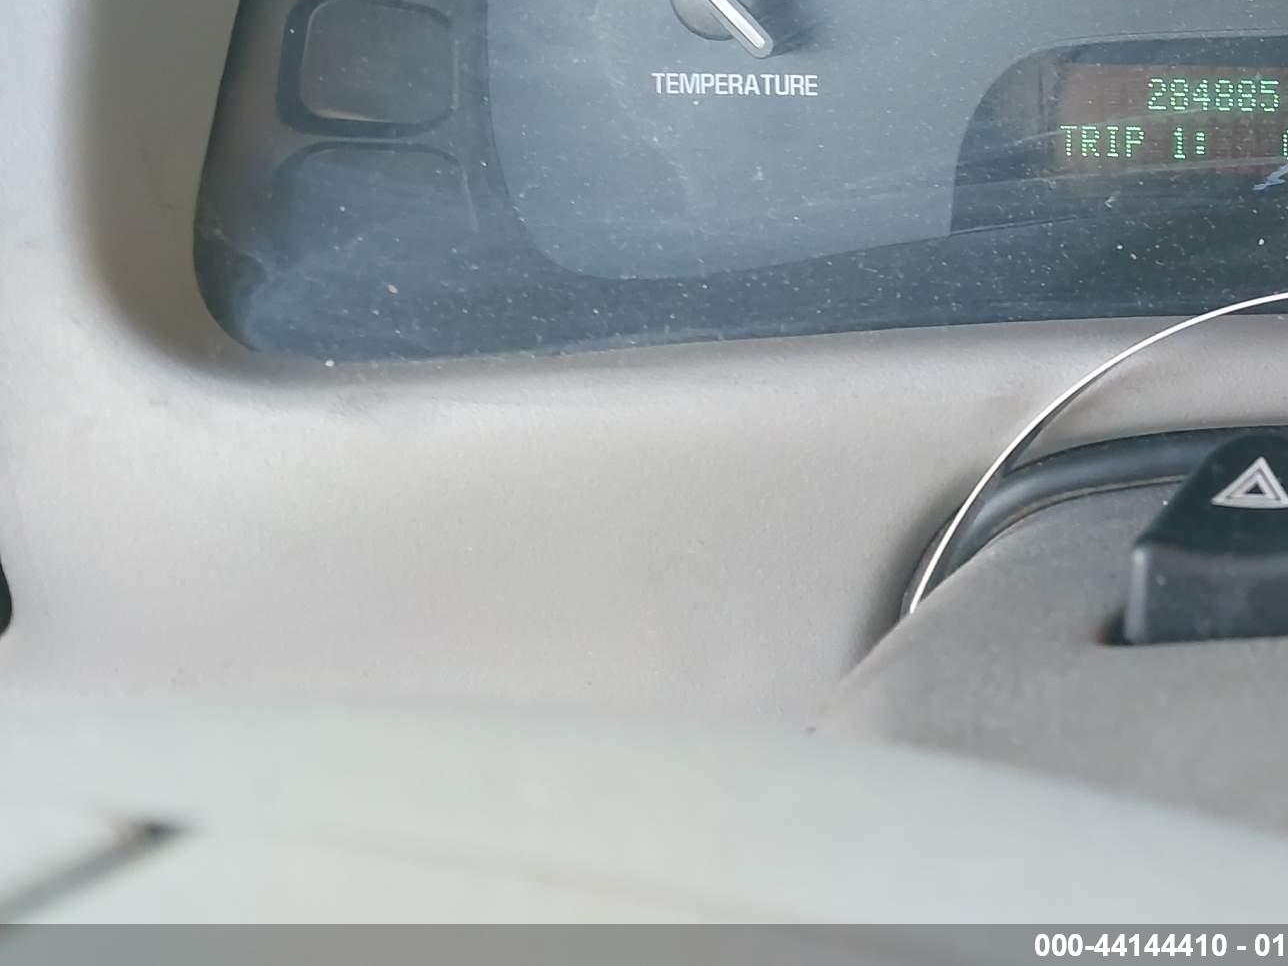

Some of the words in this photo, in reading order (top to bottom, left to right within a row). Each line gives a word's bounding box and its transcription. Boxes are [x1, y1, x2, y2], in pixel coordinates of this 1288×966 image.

[652, 72, 819, 98] TEMPERATURE
[1146, 77, 1281, 114] 284885
[1059, 124, 1146, 160] TRIP
[1173, 127, 1207, 161] 1:
